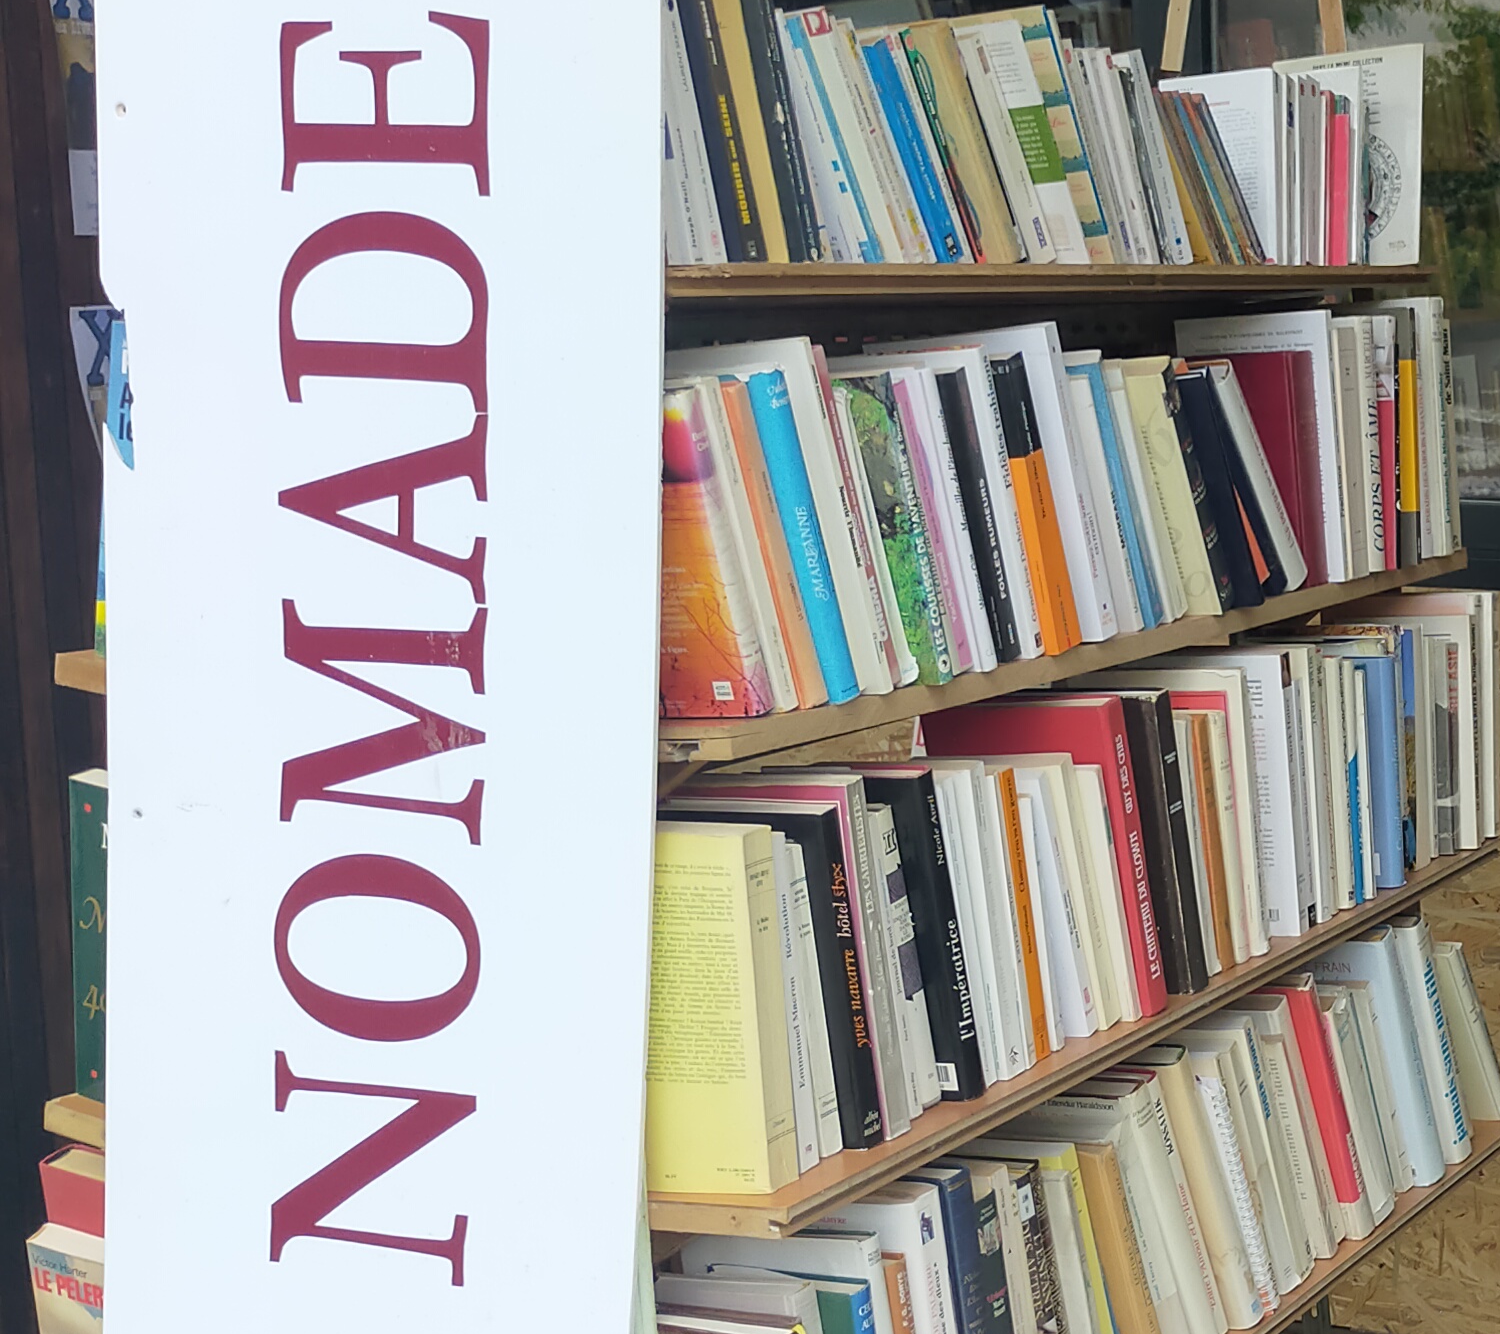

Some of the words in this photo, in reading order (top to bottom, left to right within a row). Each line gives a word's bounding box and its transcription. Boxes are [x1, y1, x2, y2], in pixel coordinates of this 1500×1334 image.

[982, 354, 1002, 429] trahisons
[1364, 397, 1379, 442] ÂME
[996, 433, 1013, 489] Fidèles
[1368, 448, 1382, 476] ET
[896, 453, 923, 532] L'AVENTURE
[978, 477, 998, 547] RUMEURS
[1367, 481, 1387, 552] CORPS
[914, 533, 927, 553] DE
[916, 555, 943, 626] COULISSES
[992, 550, 1008, 600] FOLLES
[1115, 732, 1126, 764] CARS
[1119, 765, 1130, 787] DES
[926, 793, 939, 825] Avril
[1123, 790, 1134, 814] GUY
[932, 827, 945, 865] Nicole
[1129, 829, 1145, 879] CLOWN
[829, 861, 849, 899] styx
[1137, 879, 1147, 899] DU
[779, 892, 793, 959] Révolution
[832, 900, 854, 939] hôtel
[844, 947, 865, 1010] navarre
[945, 917, 977, 1041] l'Impératrice
[1149, 959, 1161, 979] LE
[788, 975, 799, 1021] Macron
[1430, 997, 1444, 1029] ma
[853, 1014, 871, 1048] yves
[1438, 1029, 1453, 1076] sans
[791, 1024, 808, 1088] Emmanuel
[1154, 1096, 1174, 1156] KONSALIK
[1443, 1076, 1465, 1146] jamais
[34, 1266, 52, 1292] LE
[925, 1261, 937, 1318] PALMYRE
[933, 1268, 942, 1298] dieux
[936, 1300, 945, 1319] des
